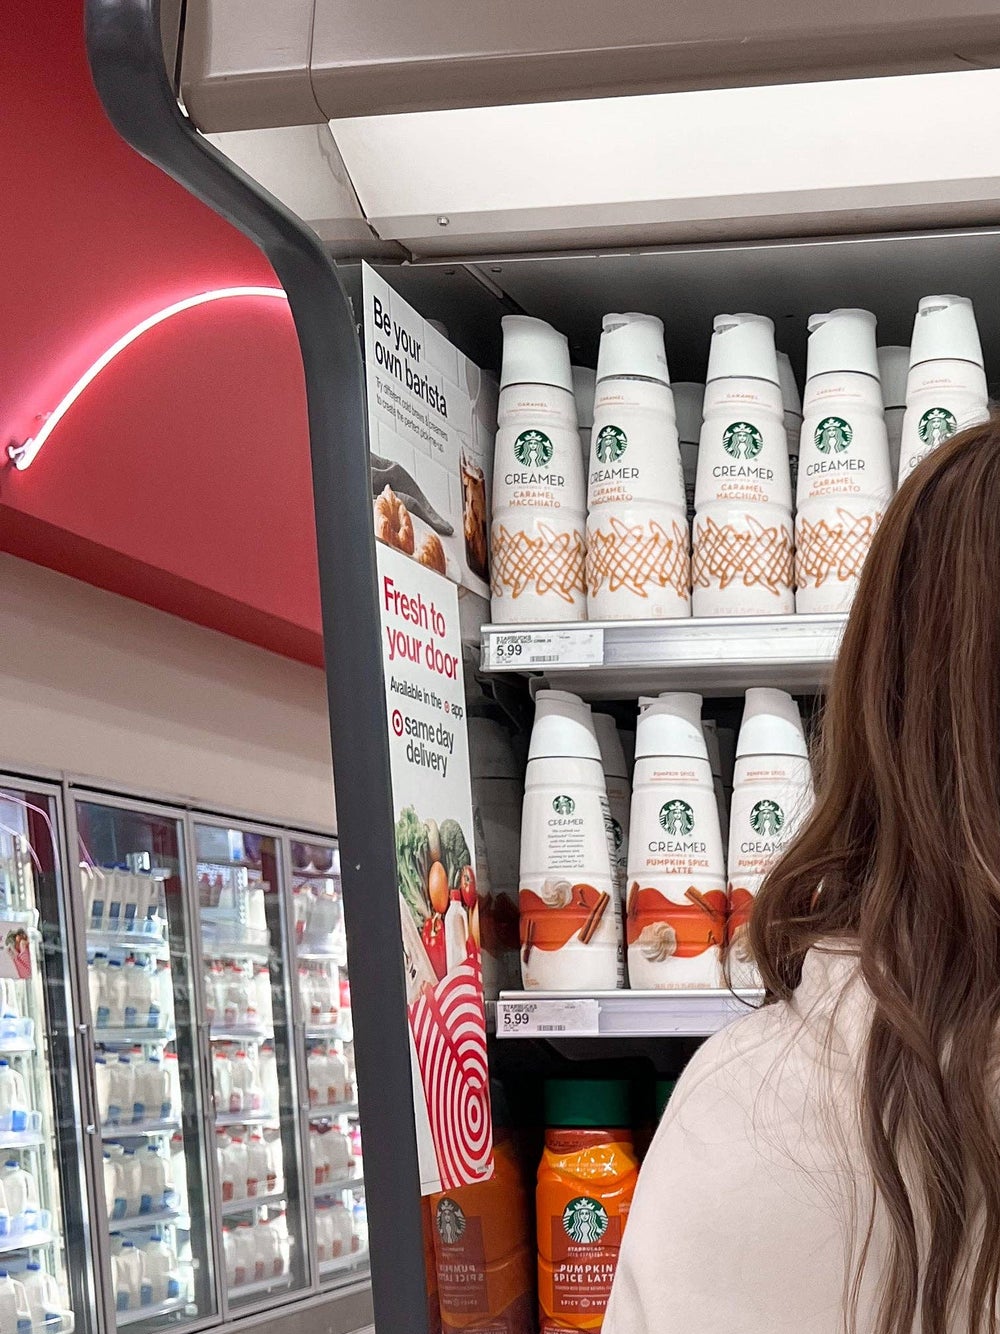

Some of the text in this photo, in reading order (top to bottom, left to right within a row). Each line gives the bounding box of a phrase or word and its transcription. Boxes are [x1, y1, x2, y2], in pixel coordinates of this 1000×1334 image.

[373, 295, 422, 364] Be your
[375, 341, 402, 382] own
[405, 358, 448, 418] barista
[712, 465, 774, 481] CREAMER
[806, 459, 866, 477] CREAMER
[505, 473, 565, 487] CREAMER
[590, 467, 640, 486] CREAMER
[813, 477, 856, 489] CARAMEL
[513, 491, 556, 499] CARAMEL
[808, 485, 861, 498] MACCHIATO
[509, 499, 561, 509] MACCHIATO
[384, 575, 446, 638] Fresh to
[386, 626, 459, 681] your door
[497, 644, 522, 656] 5.99
[390, 676, 464, 720] Available in the app
[405, 714, 454, 754] same day
[406, 740, 448, 778] delivery
[648, 841, 707, 854] CREAMER
[646, 859, 709, 868] PUMPKIN SPICE
[666, 867, 693, 875] LATTE
[503, 1013, 529, 1025] 5.99
[560, 1264, 613, 1273] PUMPKIN
[554, 1273, 614, 1282] SPICE LATT
